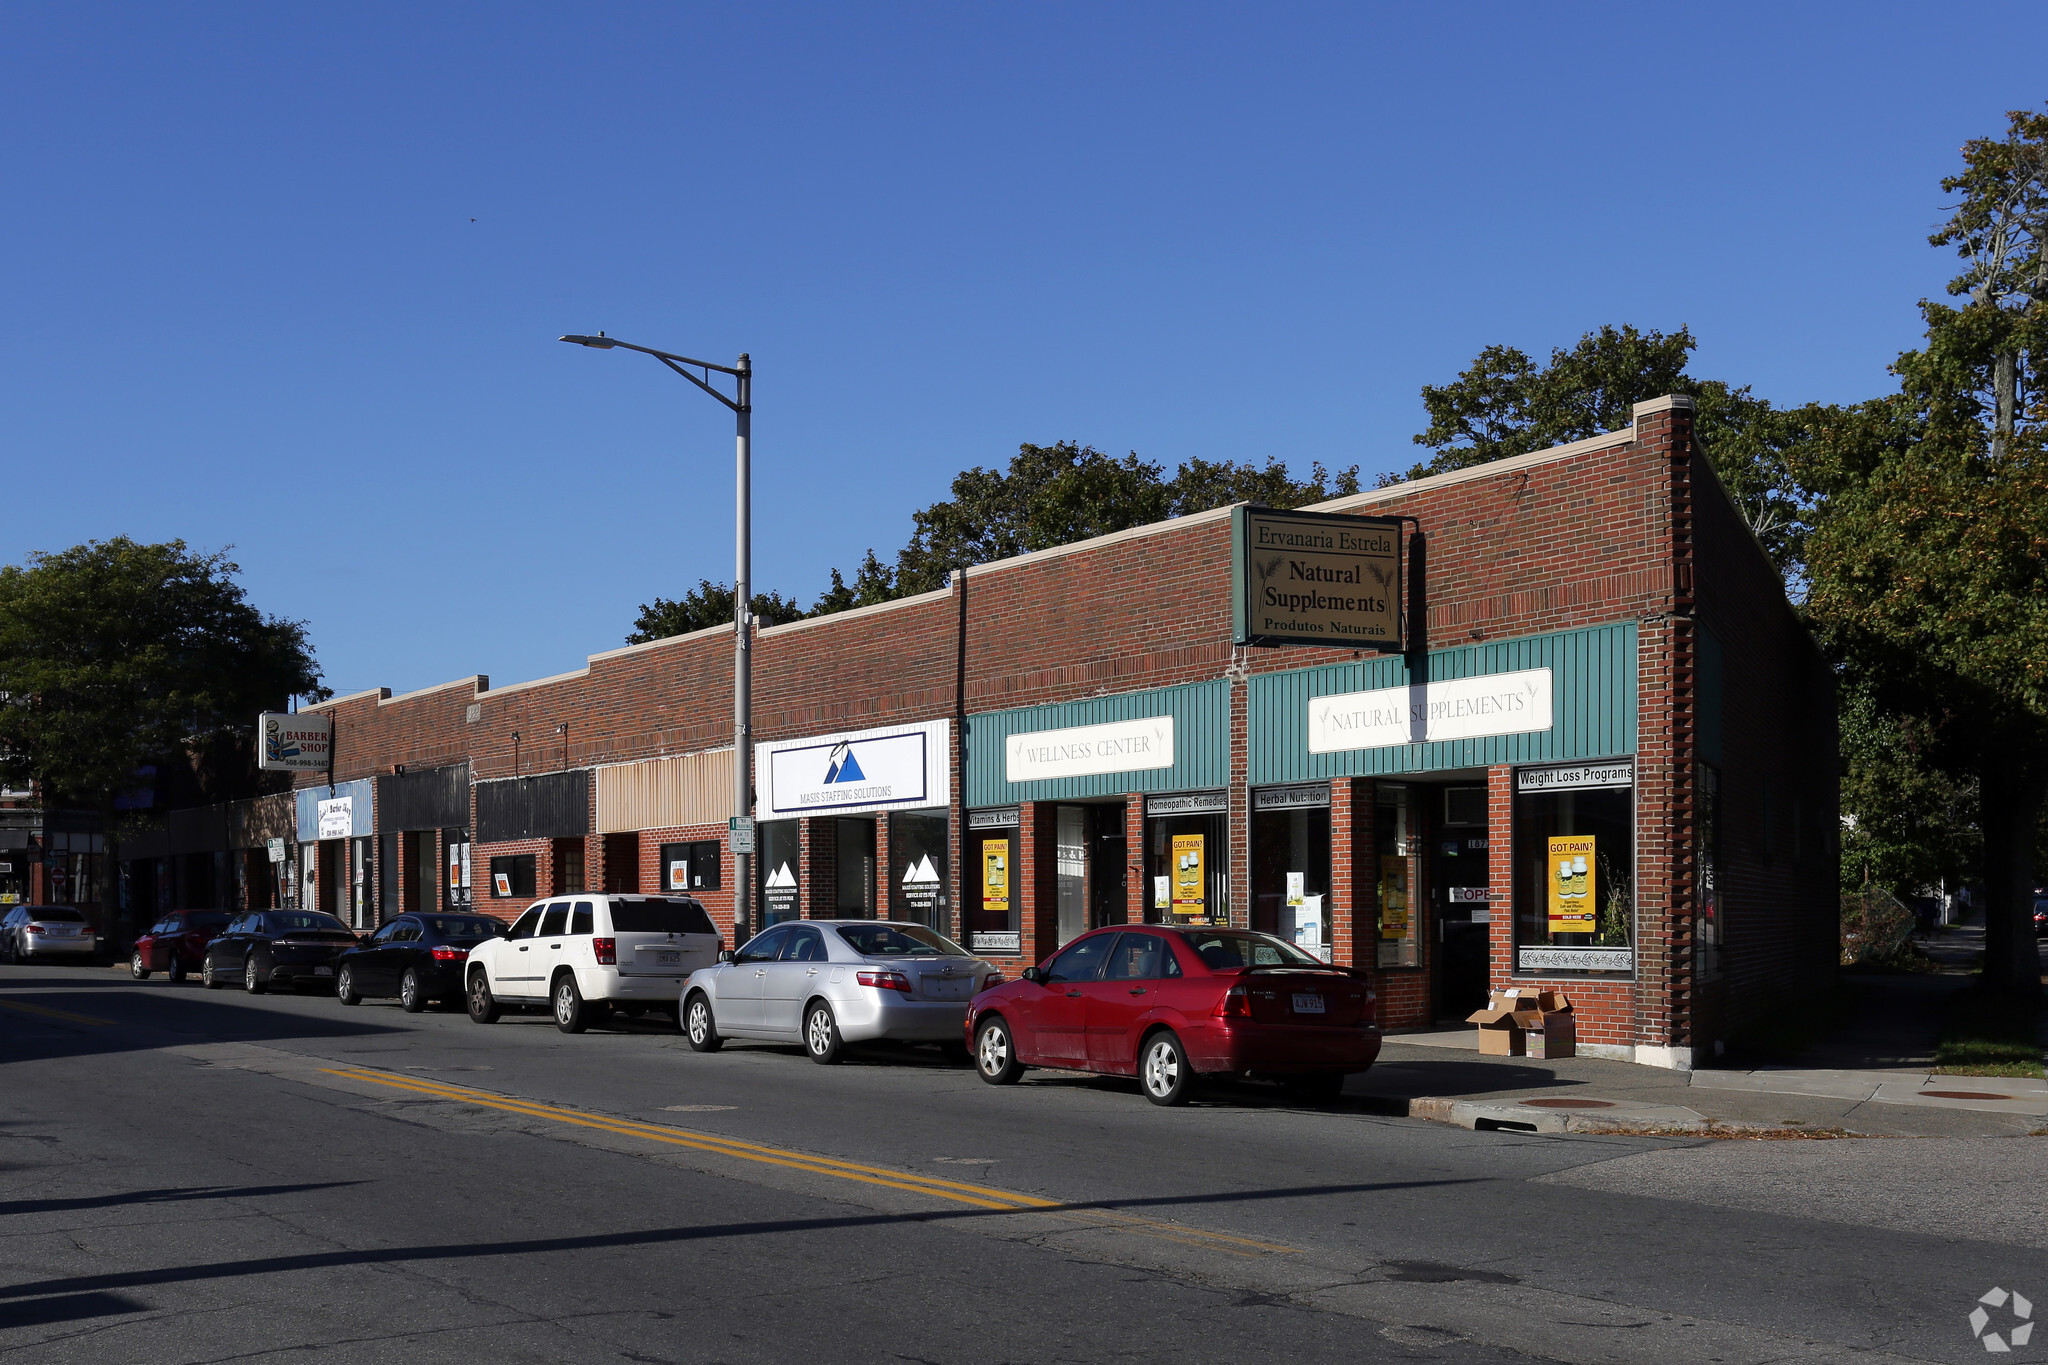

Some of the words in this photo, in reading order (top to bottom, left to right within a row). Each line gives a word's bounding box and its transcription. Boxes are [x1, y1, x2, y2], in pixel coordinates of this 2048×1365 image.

[1258, 527, 1333, 549] Ervanaria
[1339, 532, 1391, 552] Estrela
[1288, 561, 1361, 584] Natural
[1265, 586, 1385, 613] Supplements
[1264, 617, 1324, 632] Produtos
[1330, 621, 1386, 635] Naturais
[1332, 708, 1402, 731] NATURAL
[1410, 692, 1524, 722] SUPPLEMENTS
[286, 731, 328, 741] BARBER
[301, 743, 328, 753] SHOP
[1027, 742, 1092, 763] WELLNESS
[1097, 736, 1150, 756] CENTER
[1520, 771, 1554, 787] Weight
[1556, 771, 1580, 782] Loss
[1583, 768, 1632, 782] Programs
[800, 792, 820, 804] MASIS
[821, 789, 853, 802] STAFFING
[853, 785, 892, 799] SOLUTIONS
[1260, 793, 1287, 805] Herbal
[1289, 790, 1326, 803] Nutrition
[1149, 798, 1192, 811] Homeopathic
[1194, 797, 1227, 807] Remedies
[969, 814, 994, 824] Vitamins
[996, 813, 1001, 823] &
[1002, 813, 1020, 823] Herbs
[1186, 840, 1203, 848] PAIN?
[1550, 843, 1568, 853] GOT
[1569, 842, 1593, 852] PAIN?
[1464, 889, 1490, 900] OPE
